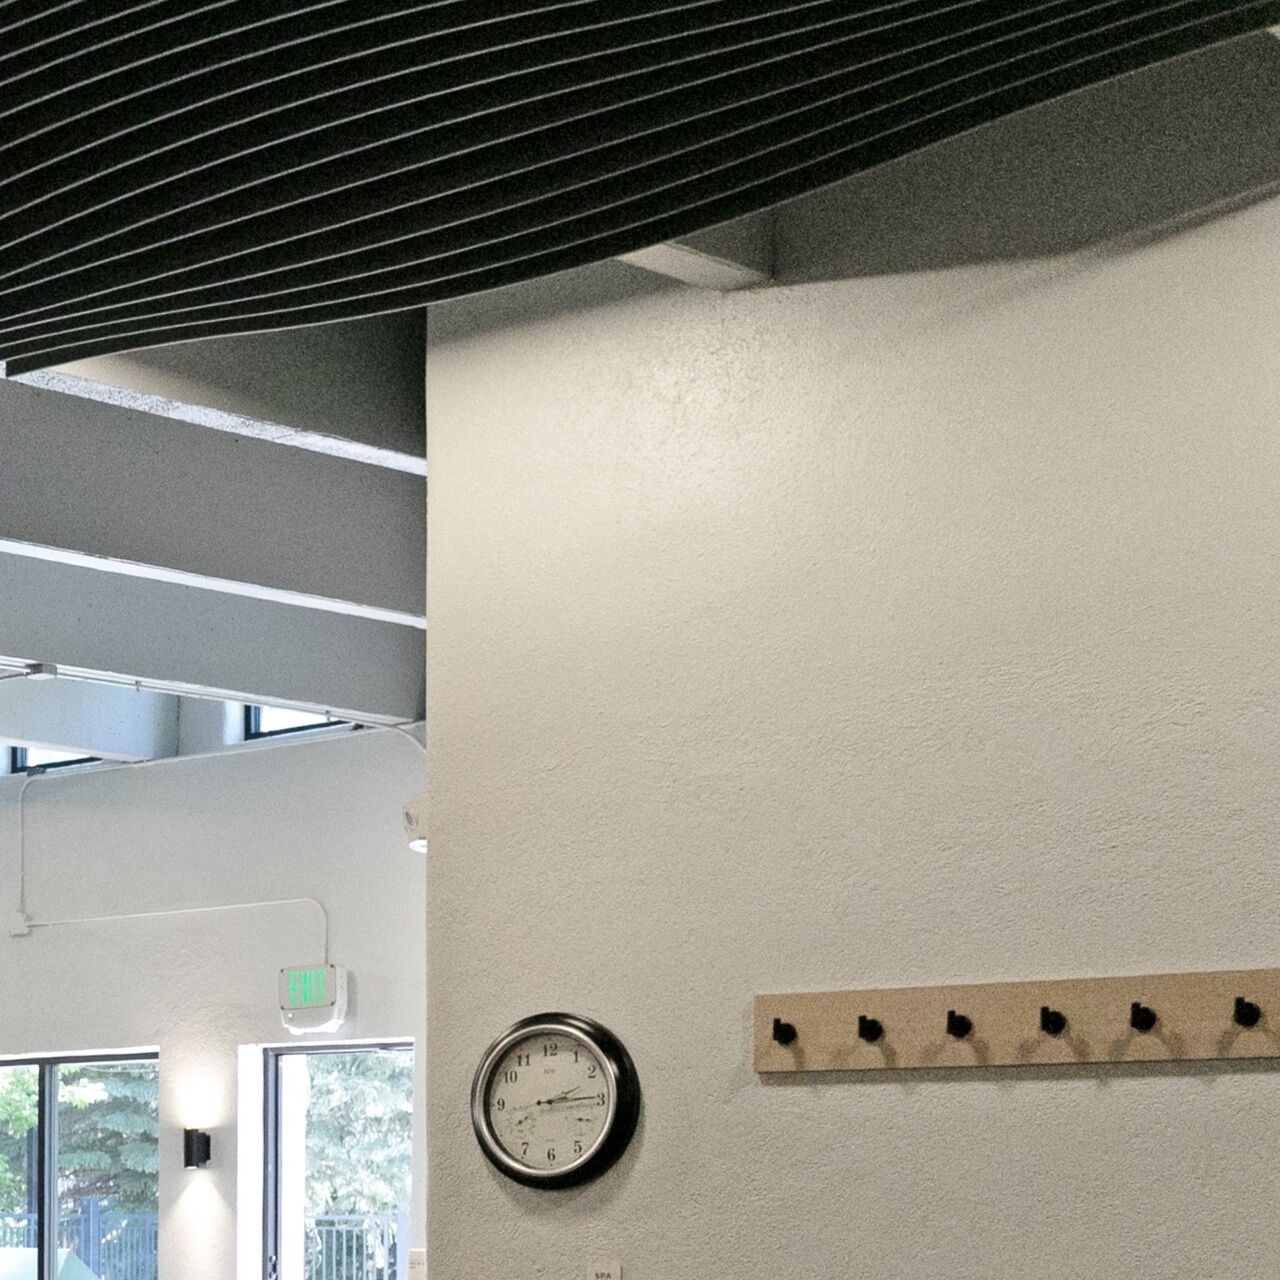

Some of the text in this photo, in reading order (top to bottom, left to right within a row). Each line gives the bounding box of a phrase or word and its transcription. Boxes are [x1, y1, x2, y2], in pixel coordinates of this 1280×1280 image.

[288, 967, 327, 1007] EXIT
[542, 1043, 559, 1057] 12
[572, 1050, 580, 1063] 1
[517, 1054, 531, 1067] 11
[504, 1070, 517, 1084] 10
[587, 1065, 597, 1079] 2
[496, 1098, 505, 1111] 9
[596, 1092, 606, 1106] 3
[521, 1142, 530, 1156] 7
[546, 1147, 556, 1161] 6
[573, 1140, 582, 1154] 5
[594, 1272, 612, 1280] SPA
